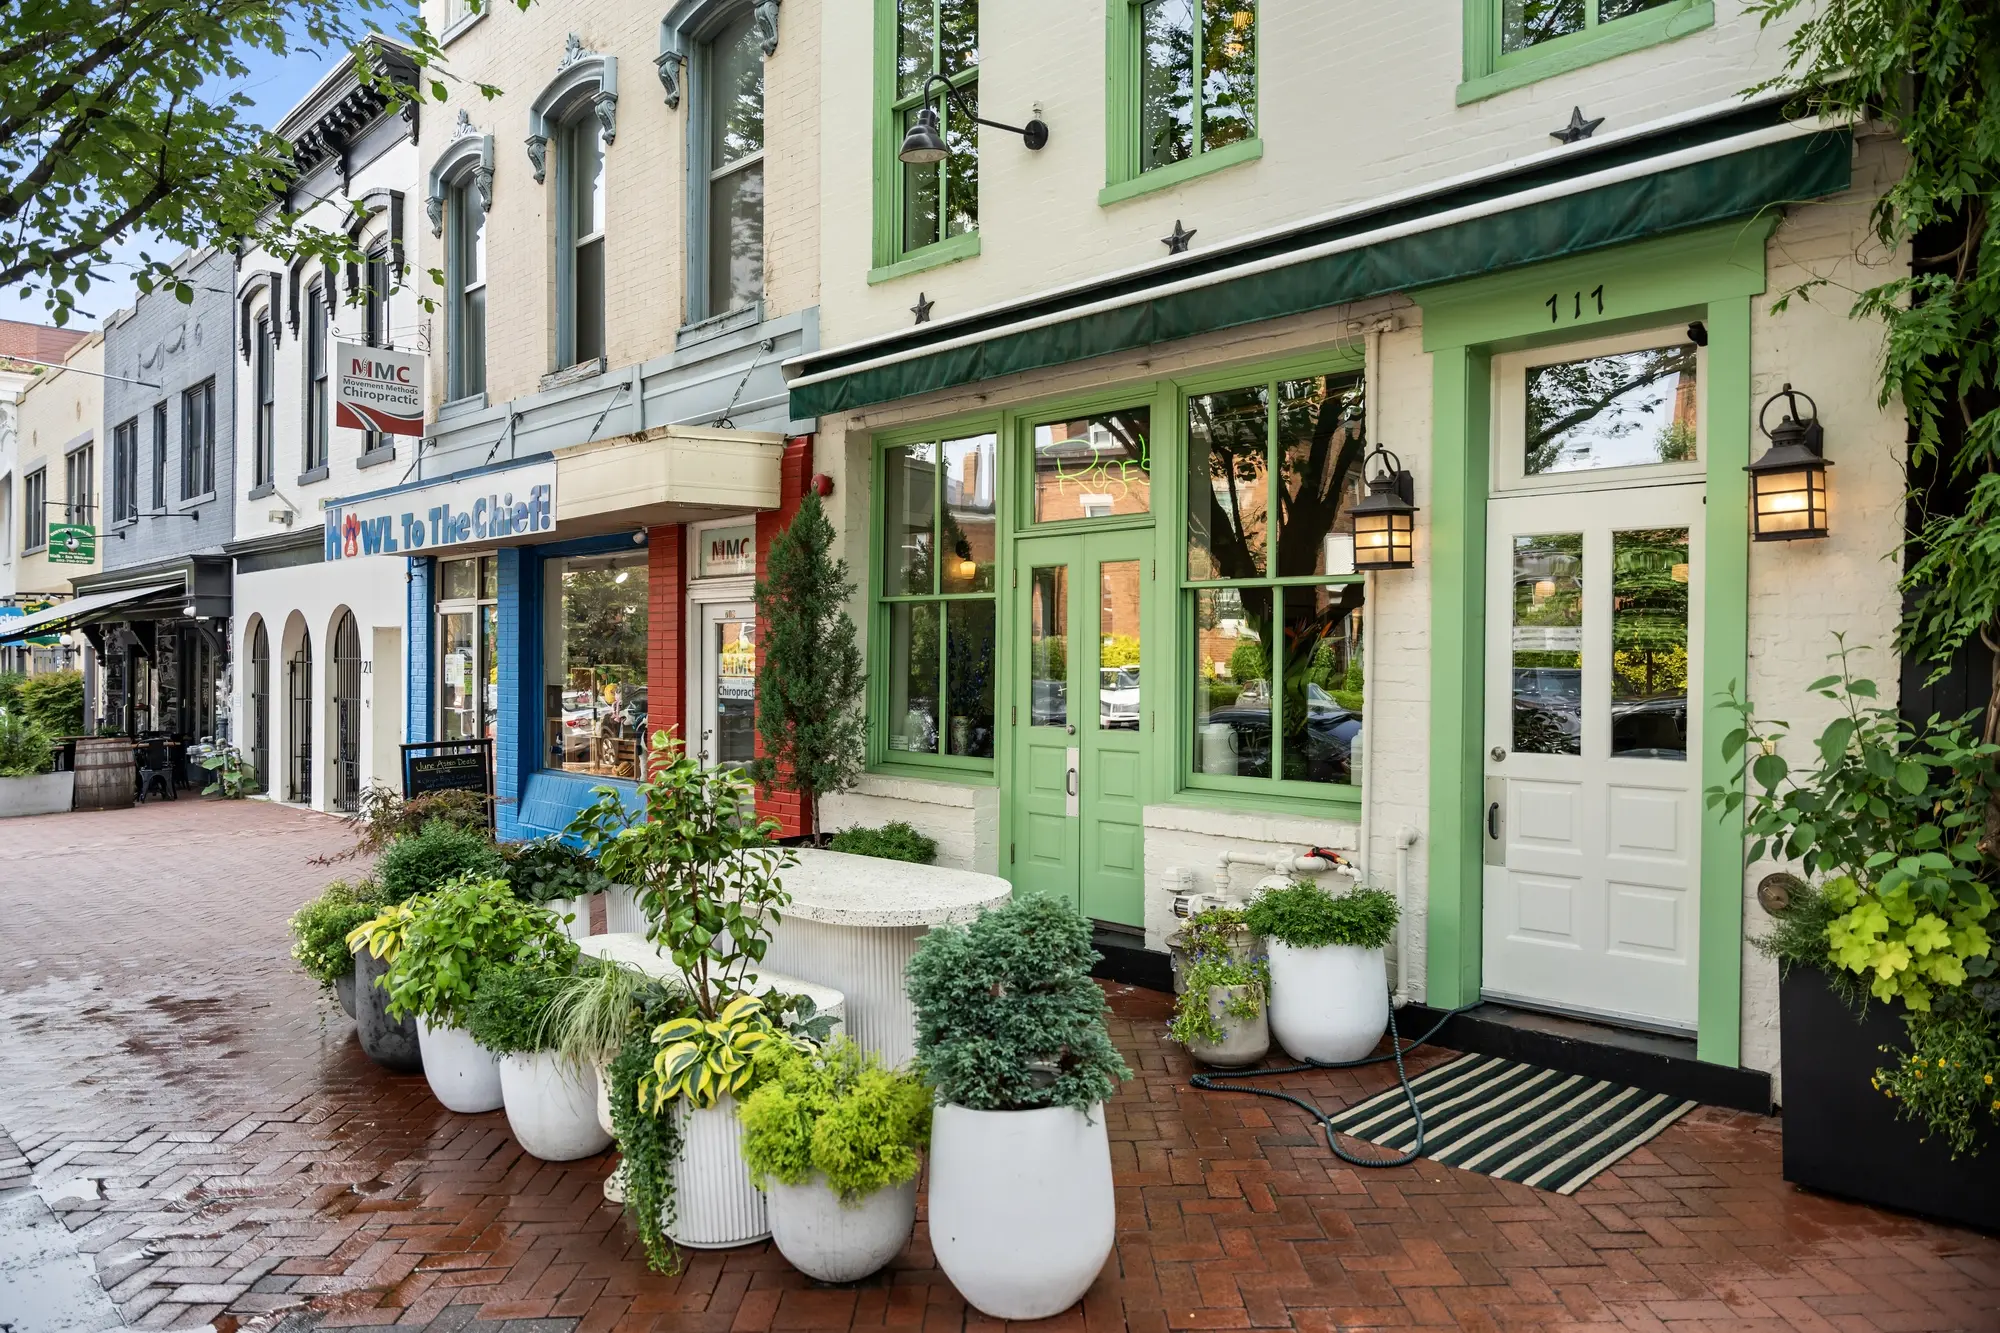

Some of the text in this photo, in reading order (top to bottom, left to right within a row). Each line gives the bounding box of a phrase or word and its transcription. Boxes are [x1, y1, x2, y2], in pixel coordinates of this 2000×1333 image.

[352, 357, 410, 384] MMC
[343, 378, 419, 395] Movement Methods
[343, 386, 419, 405] Chiropractic
[401, 512, 425, 549] To
[712, 537, 750, 561] MMC
